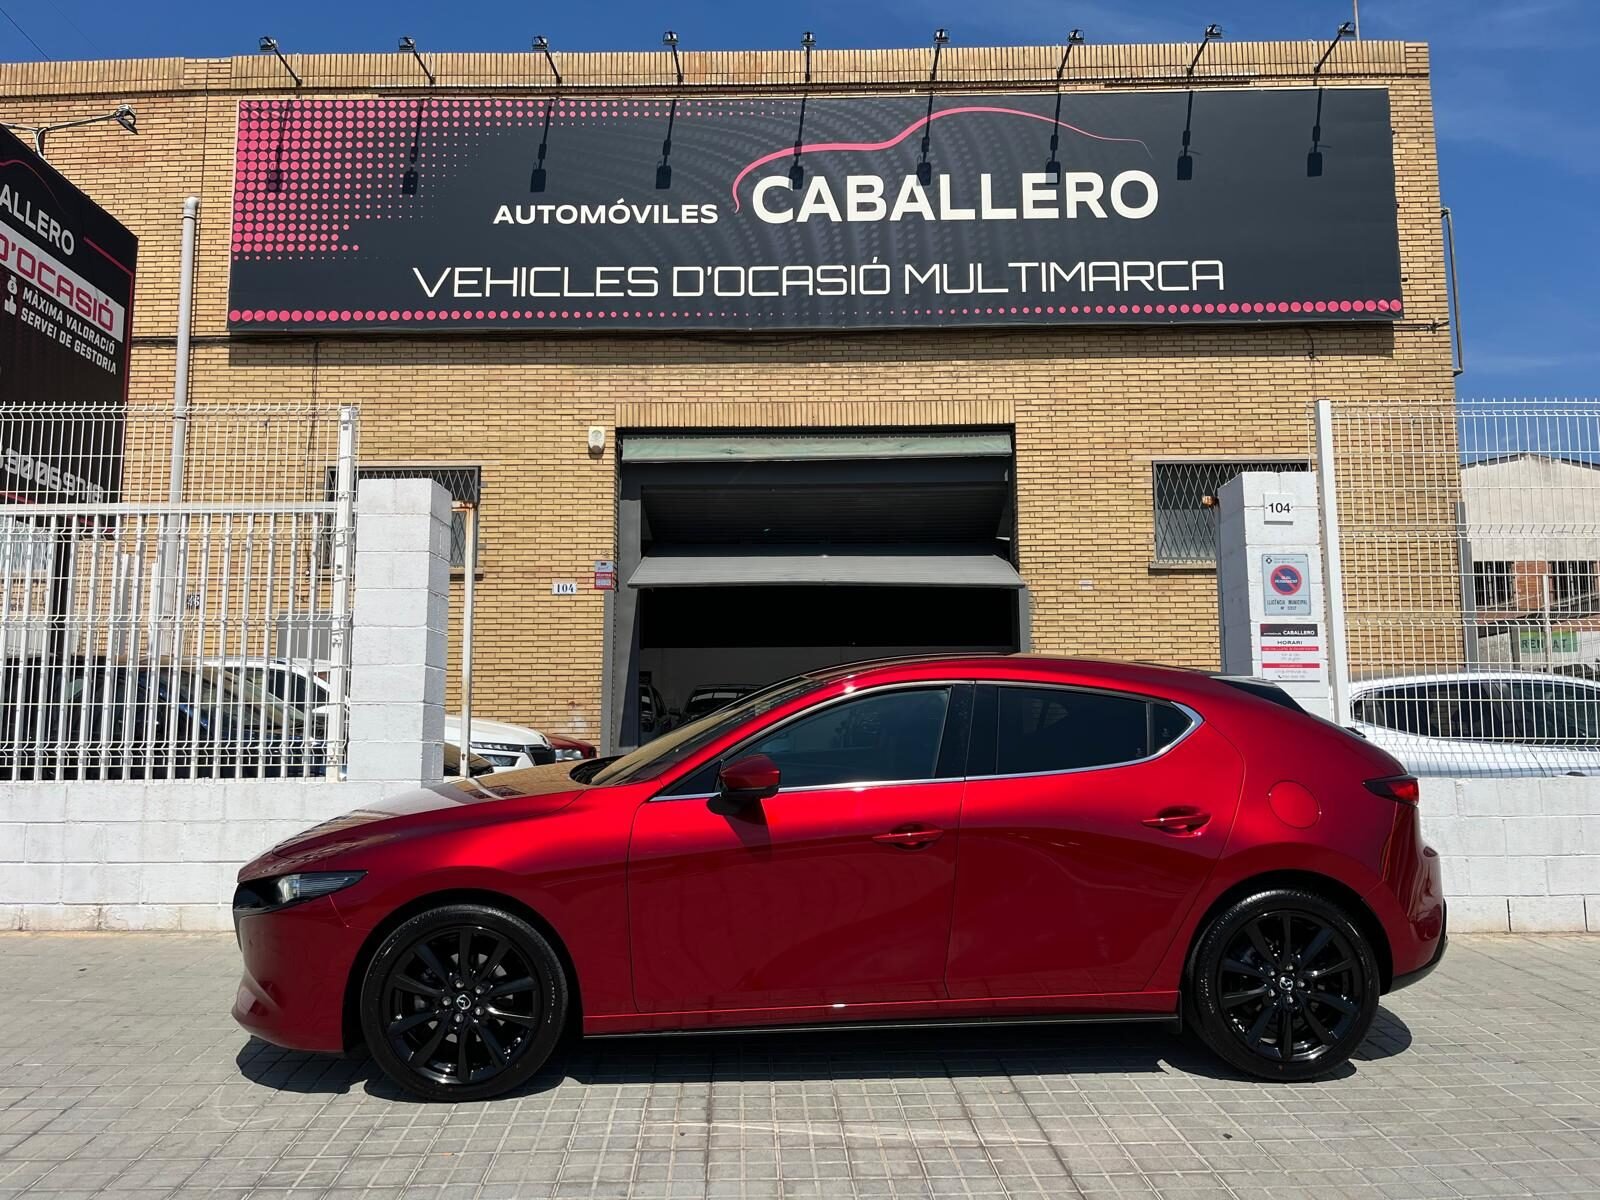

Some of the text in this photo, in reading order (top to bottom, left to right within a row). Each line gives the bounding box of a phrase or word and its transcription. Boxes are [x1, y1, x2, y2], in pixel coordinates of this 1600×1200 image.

[493, 169, 1159, 225] AUTOMÓVILES CABALLERO
[412, 256, 1224, 298] VEHICLES D'OCASIÓ MULTIMARCA
[20, 307, 116, 375] SERVEI DE GESTORIA
[22, 286, 115, 355] MÀXIMA VALORACIÓ
[1268, 502, 1290, 513] 104
[557, 583, 574, 593] 104
